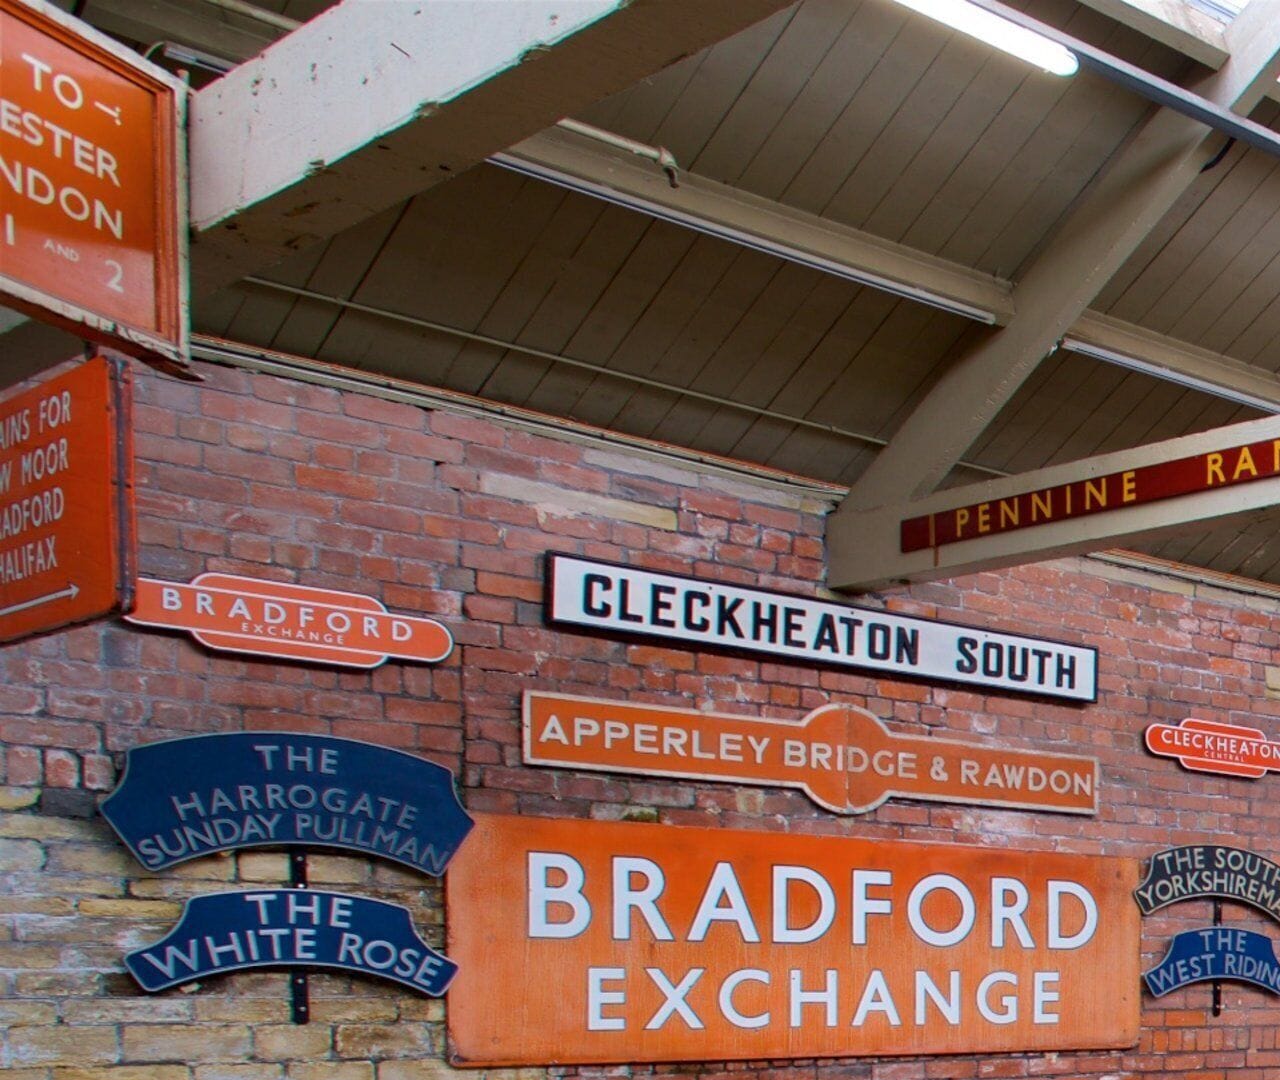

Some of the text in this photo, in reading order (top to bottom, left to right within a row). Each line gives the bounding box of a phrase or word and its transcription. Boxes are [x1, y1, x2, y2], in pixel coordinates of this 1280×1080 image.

[21, 53, 84, 110] TO
[1, 98, 121, 187] ESTER
[44, 239, 80, 262] AND
[105, 259, 125, 294] 2
[39, 391, 71, 433] FOR
[21, 438, 69, 486] MOOR
[0, 487, 64, 540] ADFORD
[955, 469, 1138, 538] PENNINE
[162, 587, 413, 642] BRADFORD
[241, 621, 346, 646] EXCHANGE
[582, 572, 1077, 690] CLECKHEATON SOUTH
[254, 743, 339, 776] THE
[539, 713, 1095, 797] APPERLEY BRIDGE & RAWDON
[1204, 749, 1245, 764] CENTRAL
[172, 784, 420, 832] HARROGATE
[137, 812, 450, 873] SUNDAY PULLMAN
[1157, 848, 1204, 875] THE
[245, 893, 354, 928] THE
[527, 850, 1099, 950] BRADFORD
[142, 927, 444, 988] WHITE ROSE
[1199, 930, 1248, 952] THE
[586, 965, 1062, 1031] EXCHANGE
[1149, 953, 1217, 993] WEST
